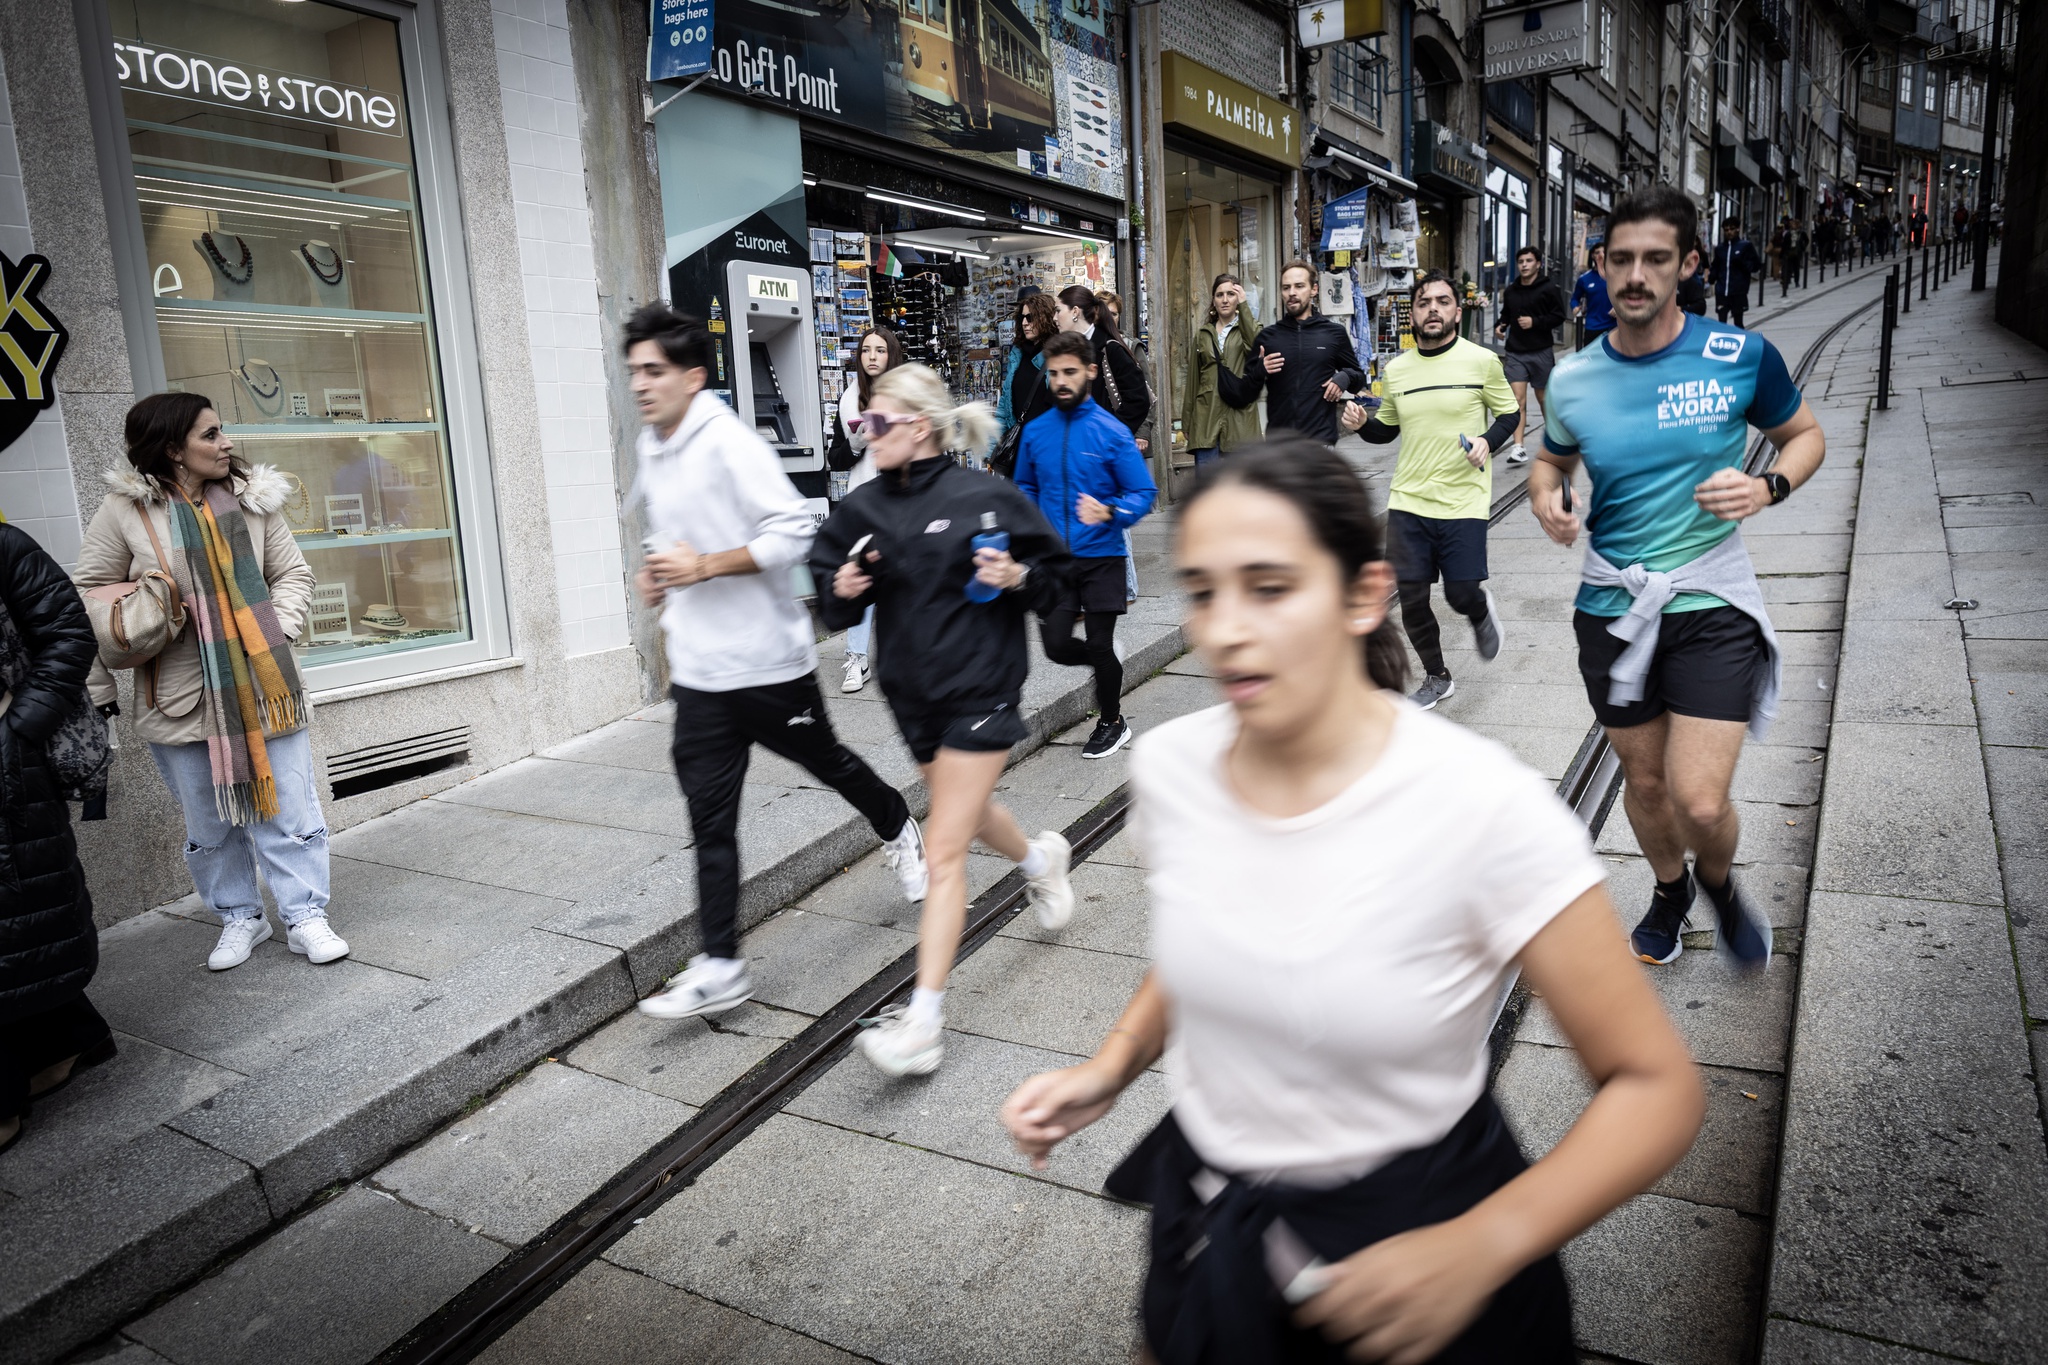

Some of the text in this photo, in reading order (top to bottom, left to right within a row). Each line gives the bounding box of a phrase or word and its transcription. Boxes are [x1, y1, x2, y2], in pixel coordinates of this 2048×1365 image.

[664, 8, 708, 25] bags here
[1486, 27, 1579, 56] OURIVESARIA
[1485, 46, 1583, 78] UNIVERSAL
[257, 73, 271, 107] BY
[737, 39, 781, 98] Gift
[784, 54, 842, 115] Point
[1184, 85, 1275, 140] 1984 PALMEIRA
[735, 231, 788, 254] Euronet
[759, 280, 788, 298] ATM
[1723, 386, 1734, 395] DE
[1678, 413, 1729, 427] PATRIMÓNIO
